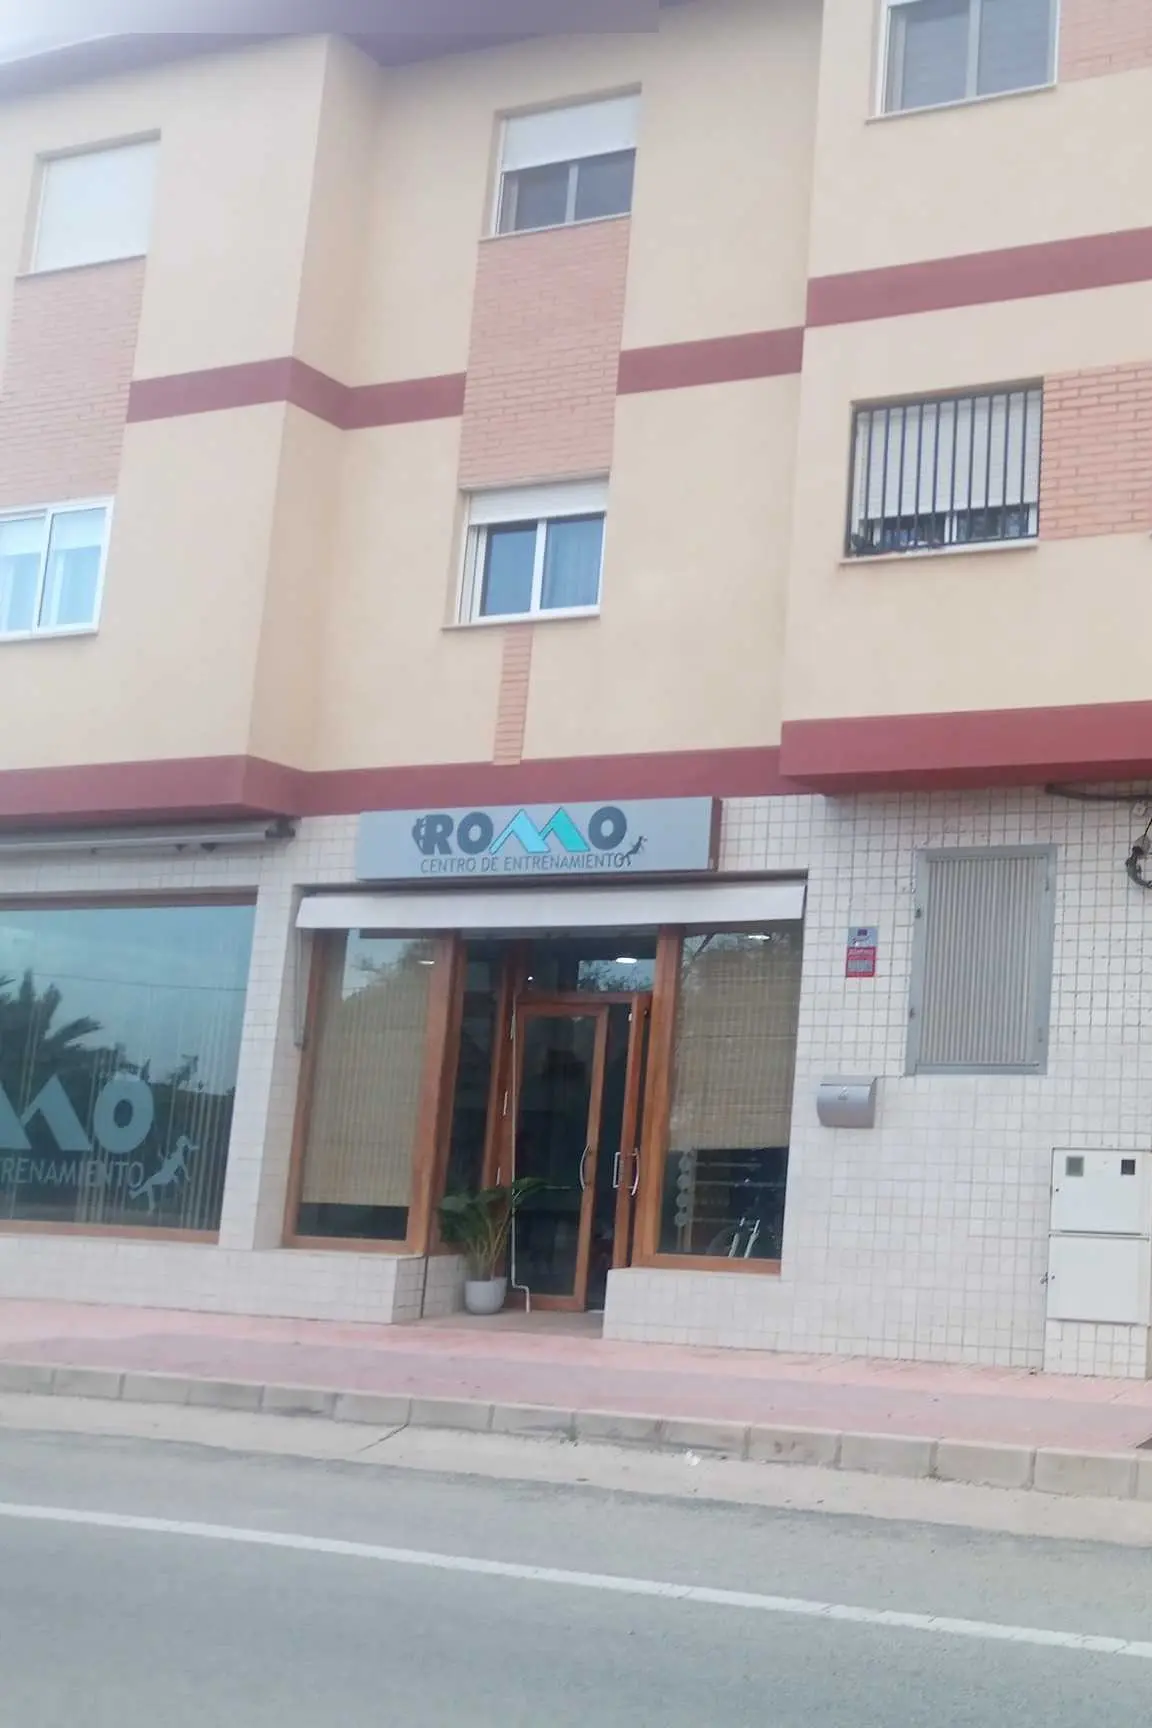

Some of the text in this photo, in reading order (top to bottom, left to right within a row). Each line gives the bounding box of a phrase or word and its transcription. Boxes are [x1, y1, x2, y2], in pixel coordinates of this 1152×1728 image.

[414, 806, 628, 856] ROMO
[420, 852, 627, 874] CENTRO DE ENTRENAMIENTO
[0, 1156, 146, 1188] RENAMIENTO
